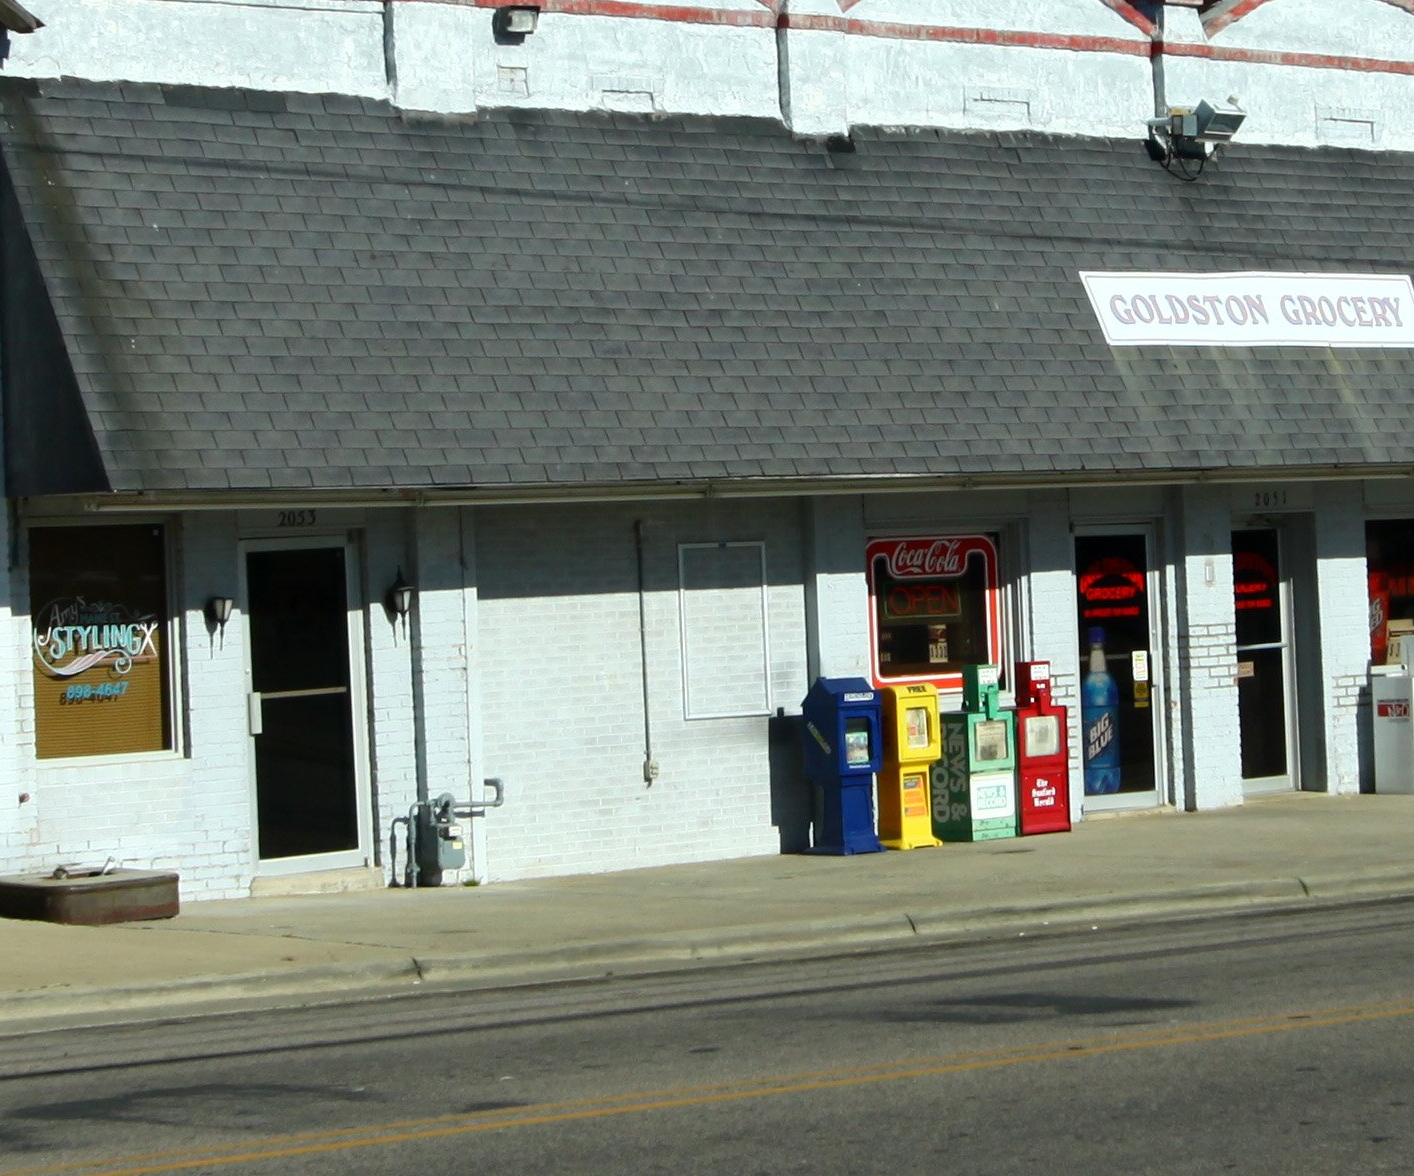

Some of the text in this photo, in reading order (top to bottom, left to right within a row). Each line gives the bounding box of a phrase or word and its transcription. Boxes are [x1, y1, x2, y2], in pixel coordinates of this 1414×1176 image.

[1109, 294, 1404, 327] GOLDSTON GROCERY
[277, 508, 316, 527] 2053
[892, 540, 961, 575] Coca-Cola
[890, 586, 958, 615] OPEN
[50, 624, 142, 659] STYLING
[906, 685, 927, 694] FREE
[1089, 724, 1114, 761] BLUE
[1090, 712, 1109, 744] BIG
[948, 723, 968, 821] NEWS &
